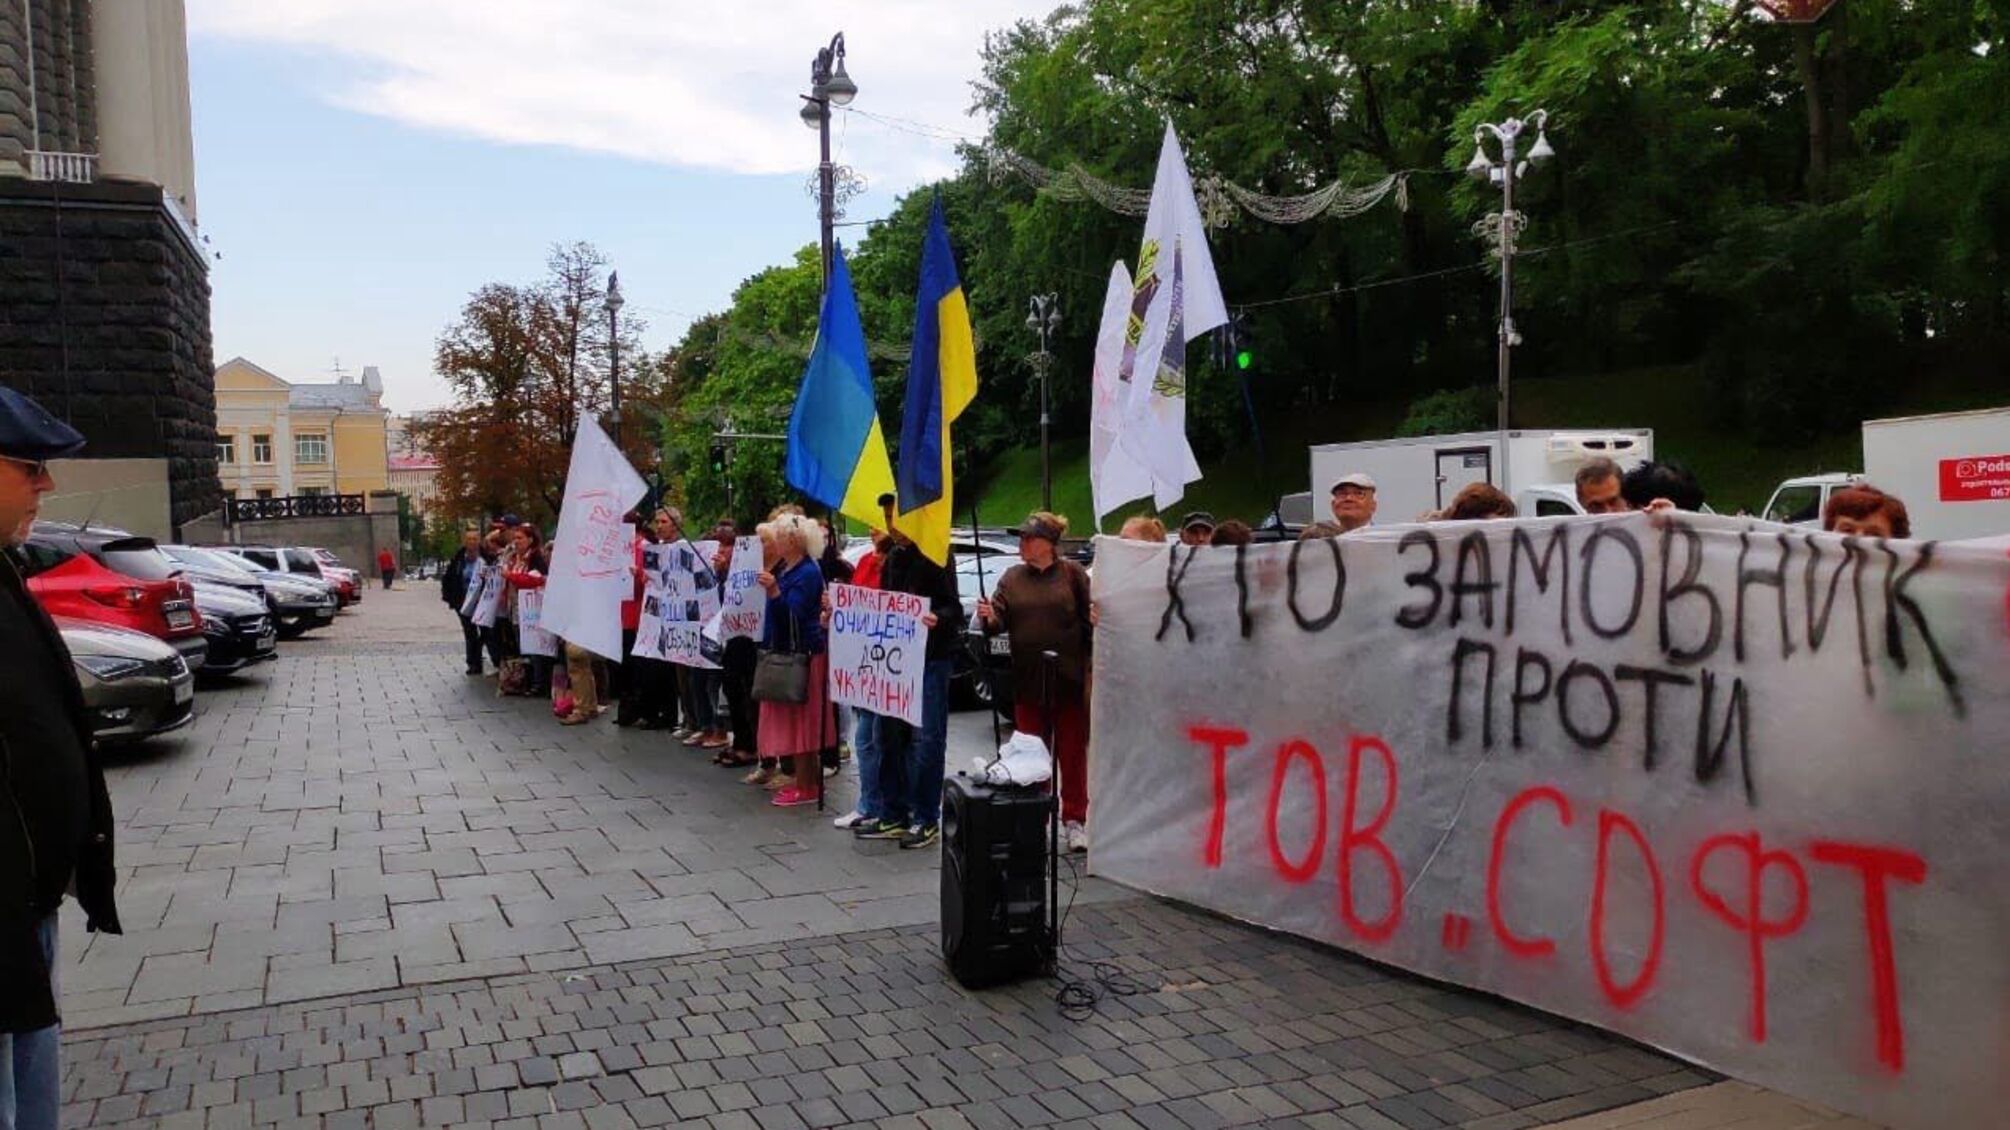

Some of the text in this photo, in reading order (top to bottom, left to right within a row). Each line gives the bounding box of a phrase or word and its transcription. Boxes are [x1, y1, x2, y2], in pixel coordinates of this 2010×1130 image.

[857, 644, 902, 676] ДФС
[1395, 520, 1967, 719] ЗАМОВНИК
[1447, 639, 1757, 806] ПРОТИ
[1187, 728, 1406, 941] ТОВ
